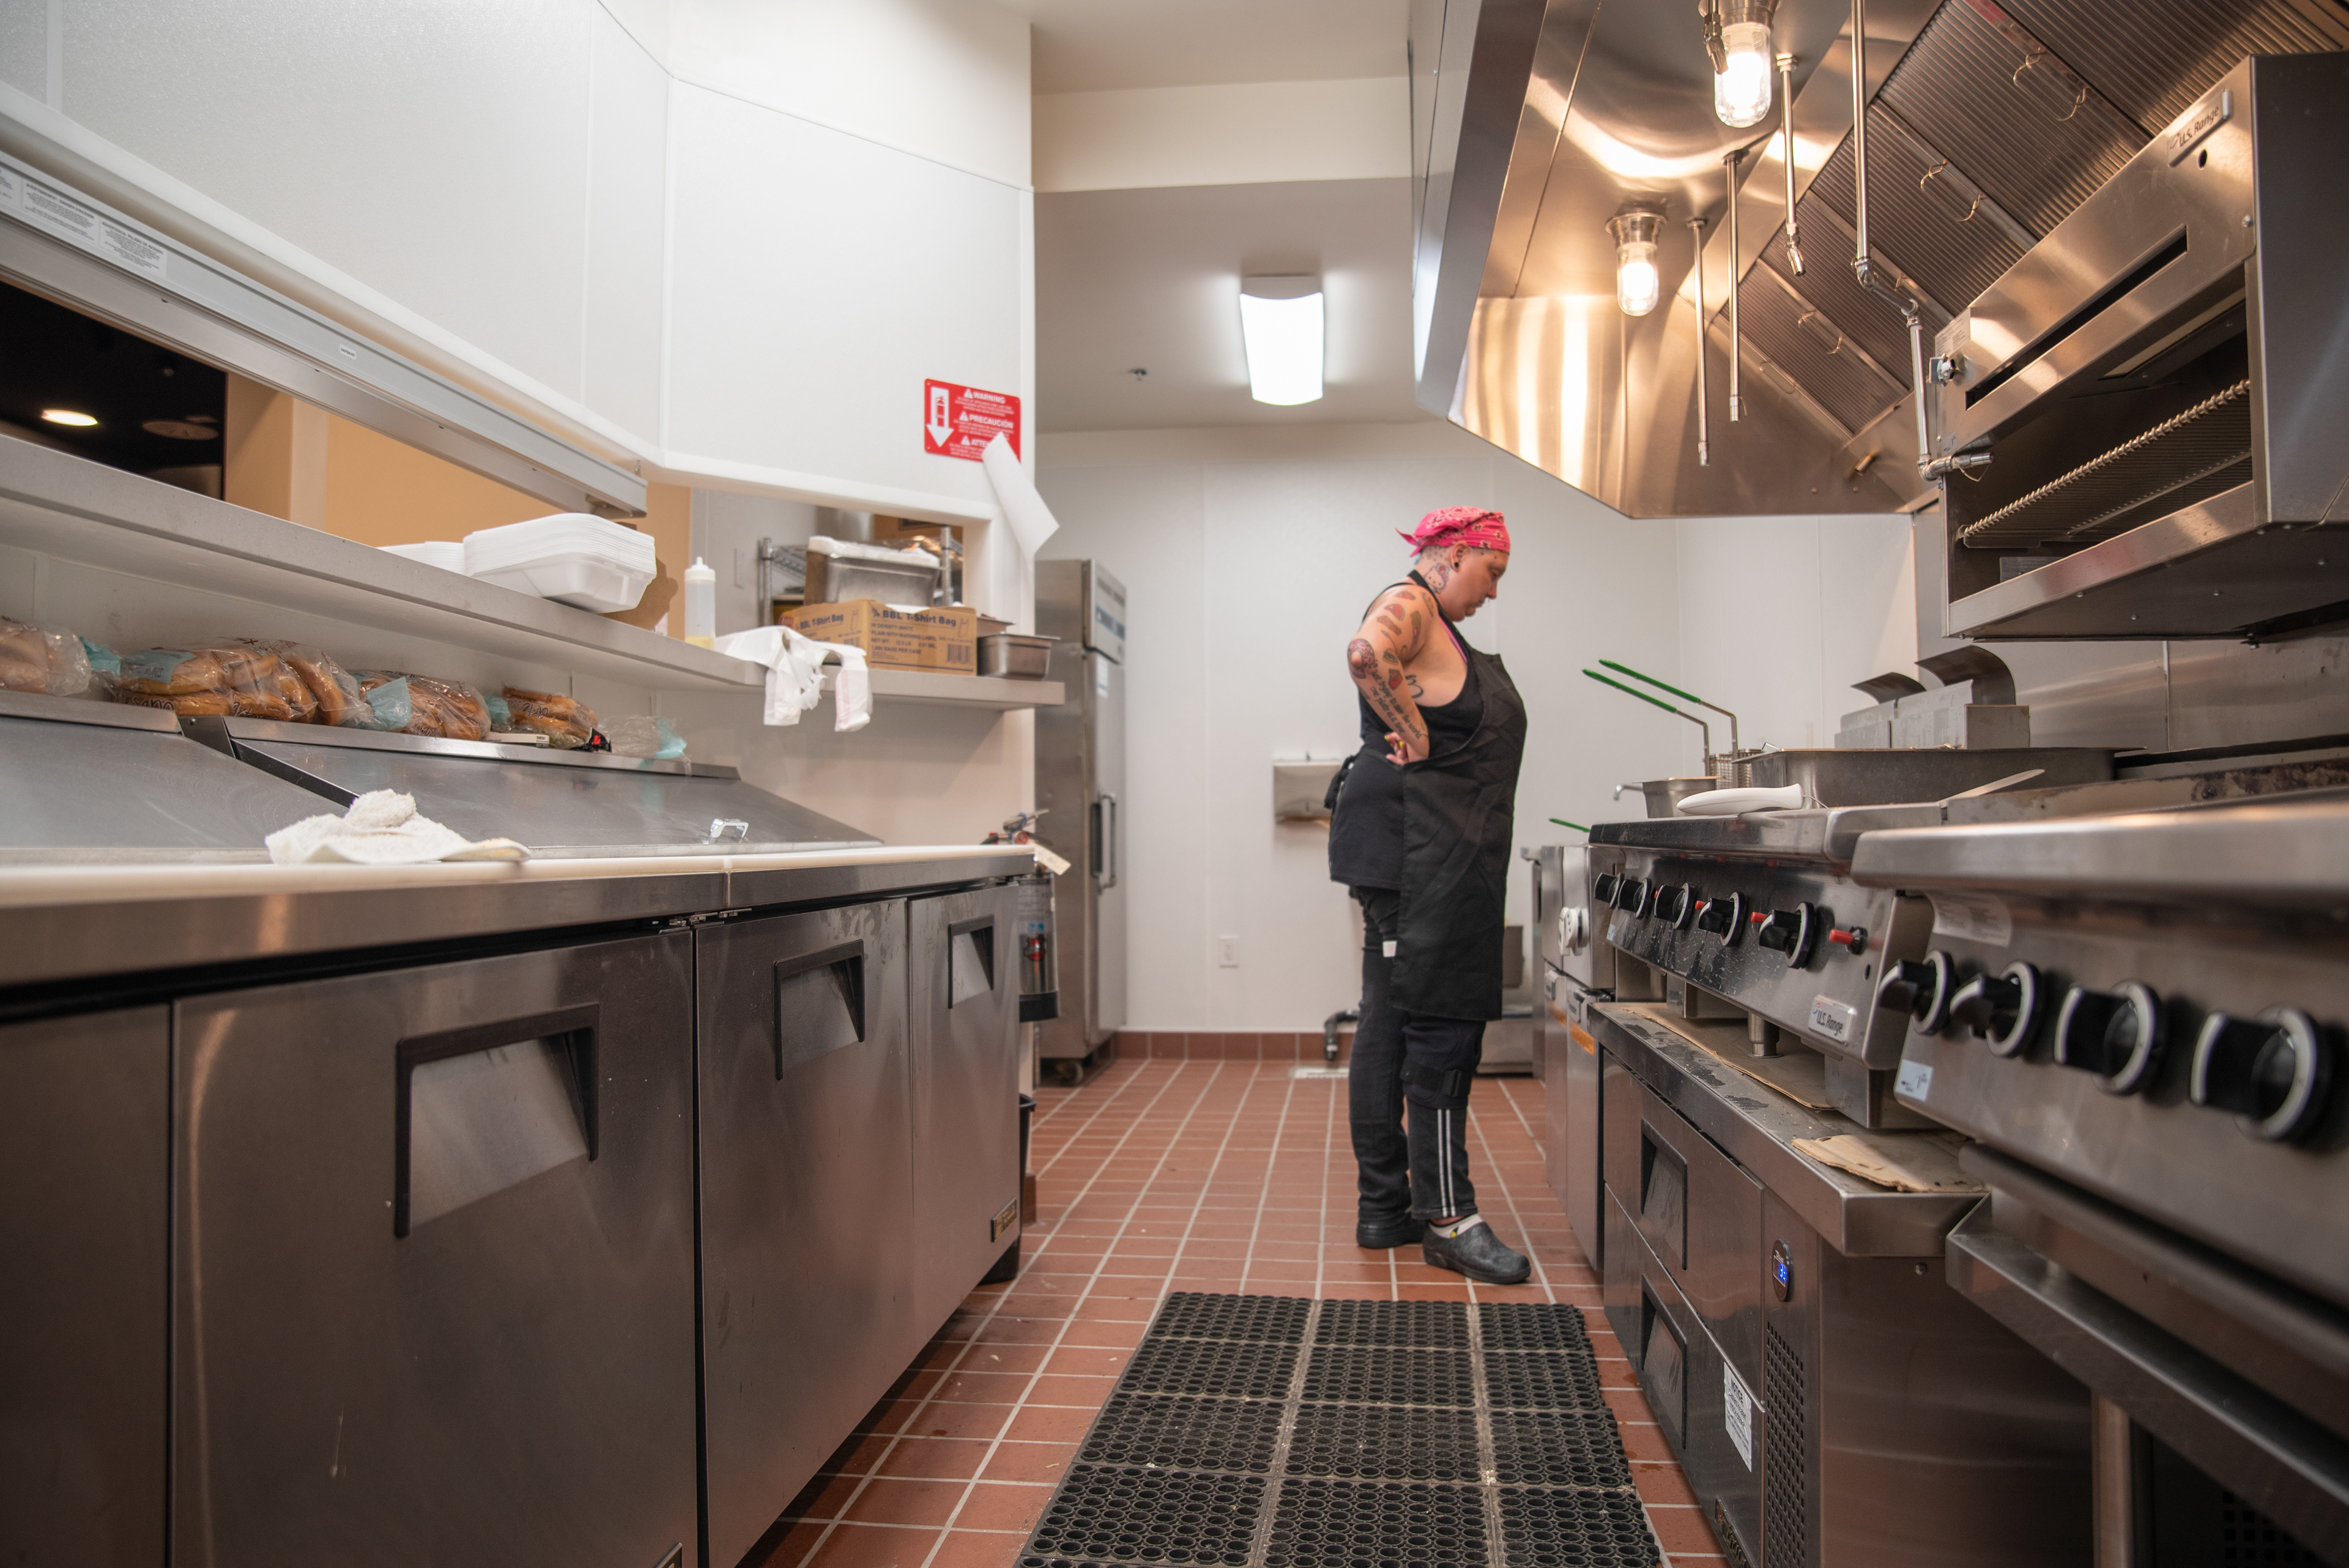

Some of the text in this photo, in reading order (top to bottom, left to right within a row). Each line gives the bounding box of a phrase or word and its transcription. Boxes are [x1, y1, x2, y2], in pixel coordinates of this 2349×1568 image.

[2194, 106, 2219, 135] Range
[973, 391, 1006, 404] WARNING
[969, 414, 1014, 429] PRECAUCIÓN
[800, 620, 811, 630] BBL
[812, 615, 831, 626] T-Shirt
[831, 614, 844, 622] Bag
[883, 610, 902, 620] BBL
[906, 612, 937, 623] T-Shirt
[938, 616, 956, 627] Bag
[1825, 1014, 1843, 1036] Range
